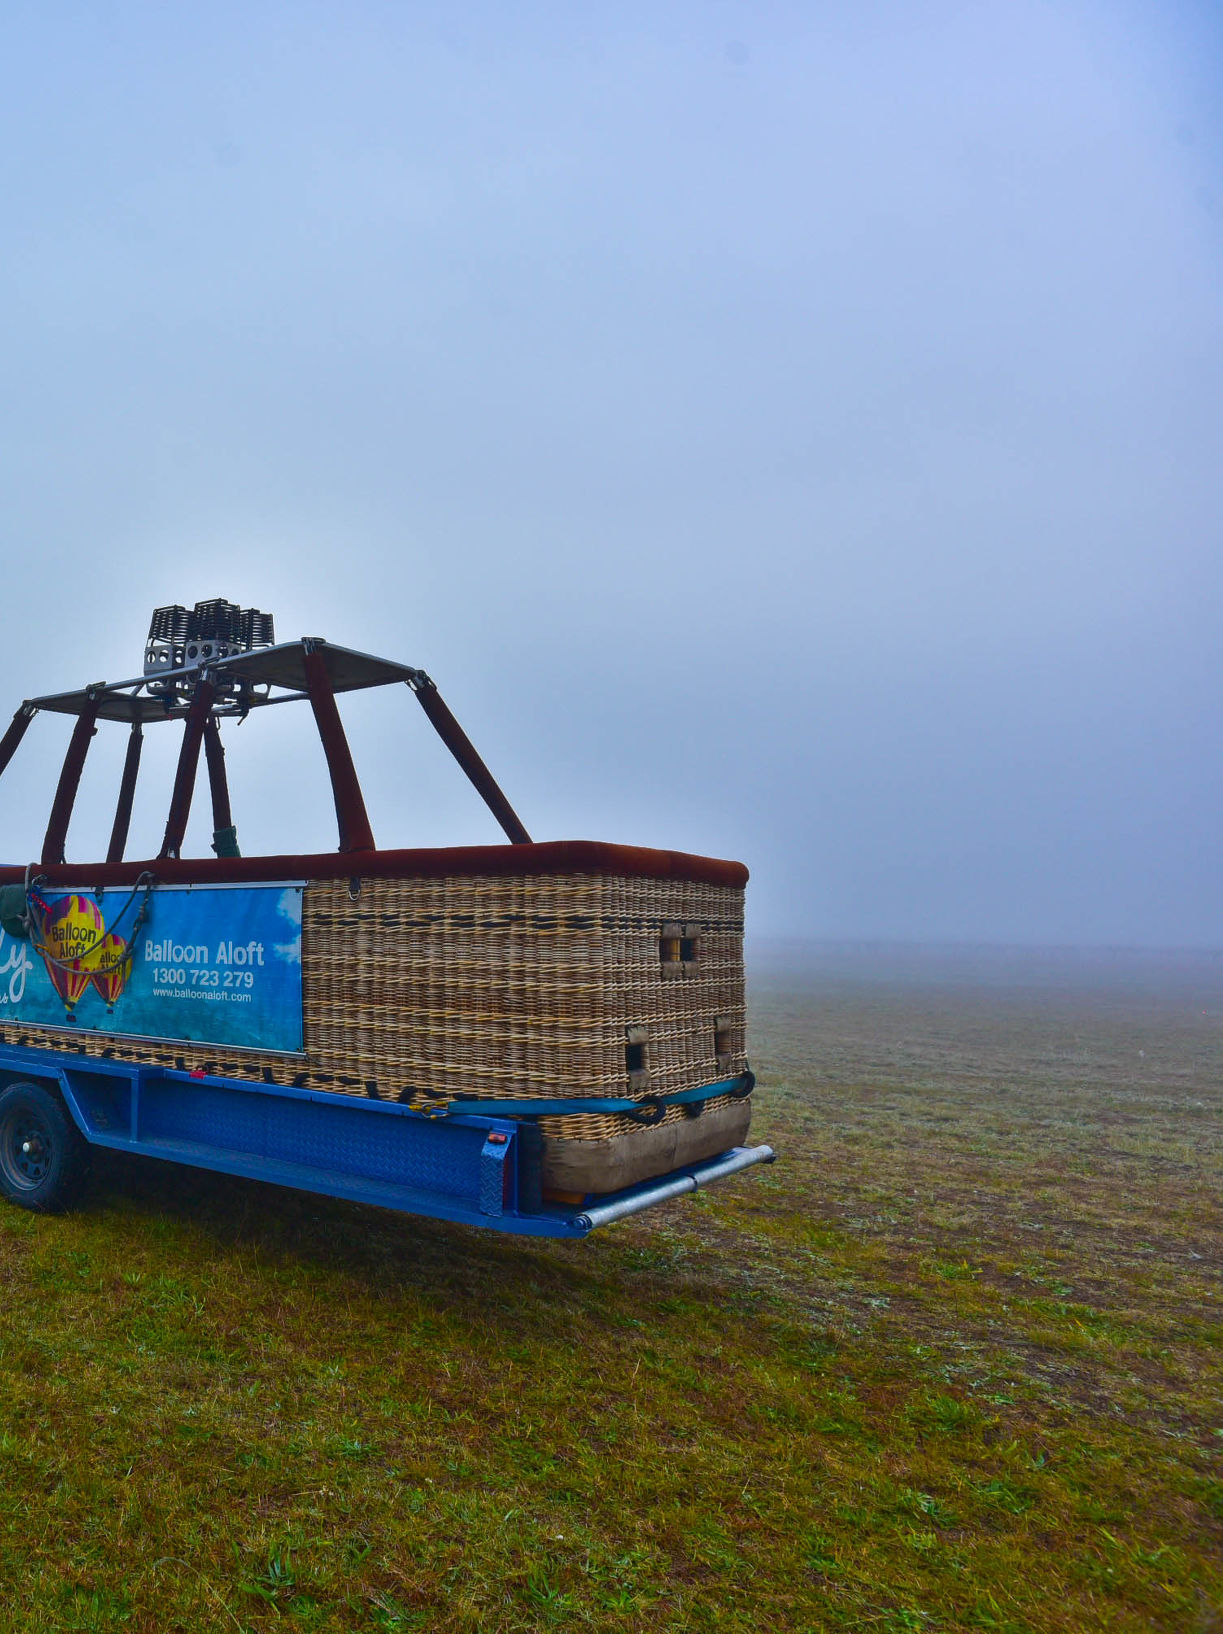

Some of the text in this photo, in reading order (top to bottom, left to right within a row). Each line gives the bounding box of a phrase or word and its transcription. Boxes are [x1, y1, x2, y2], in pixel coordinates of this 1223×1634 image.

[52, 922, 96, 944] Balloon
[60, 942, 86, 959] Aloft
[145, 940, 264, 966] Balloon Aloft
[153, 967, 254, 988] 1300 723 279
[153, 988, 251, 1002] www.balloonaloft.com
